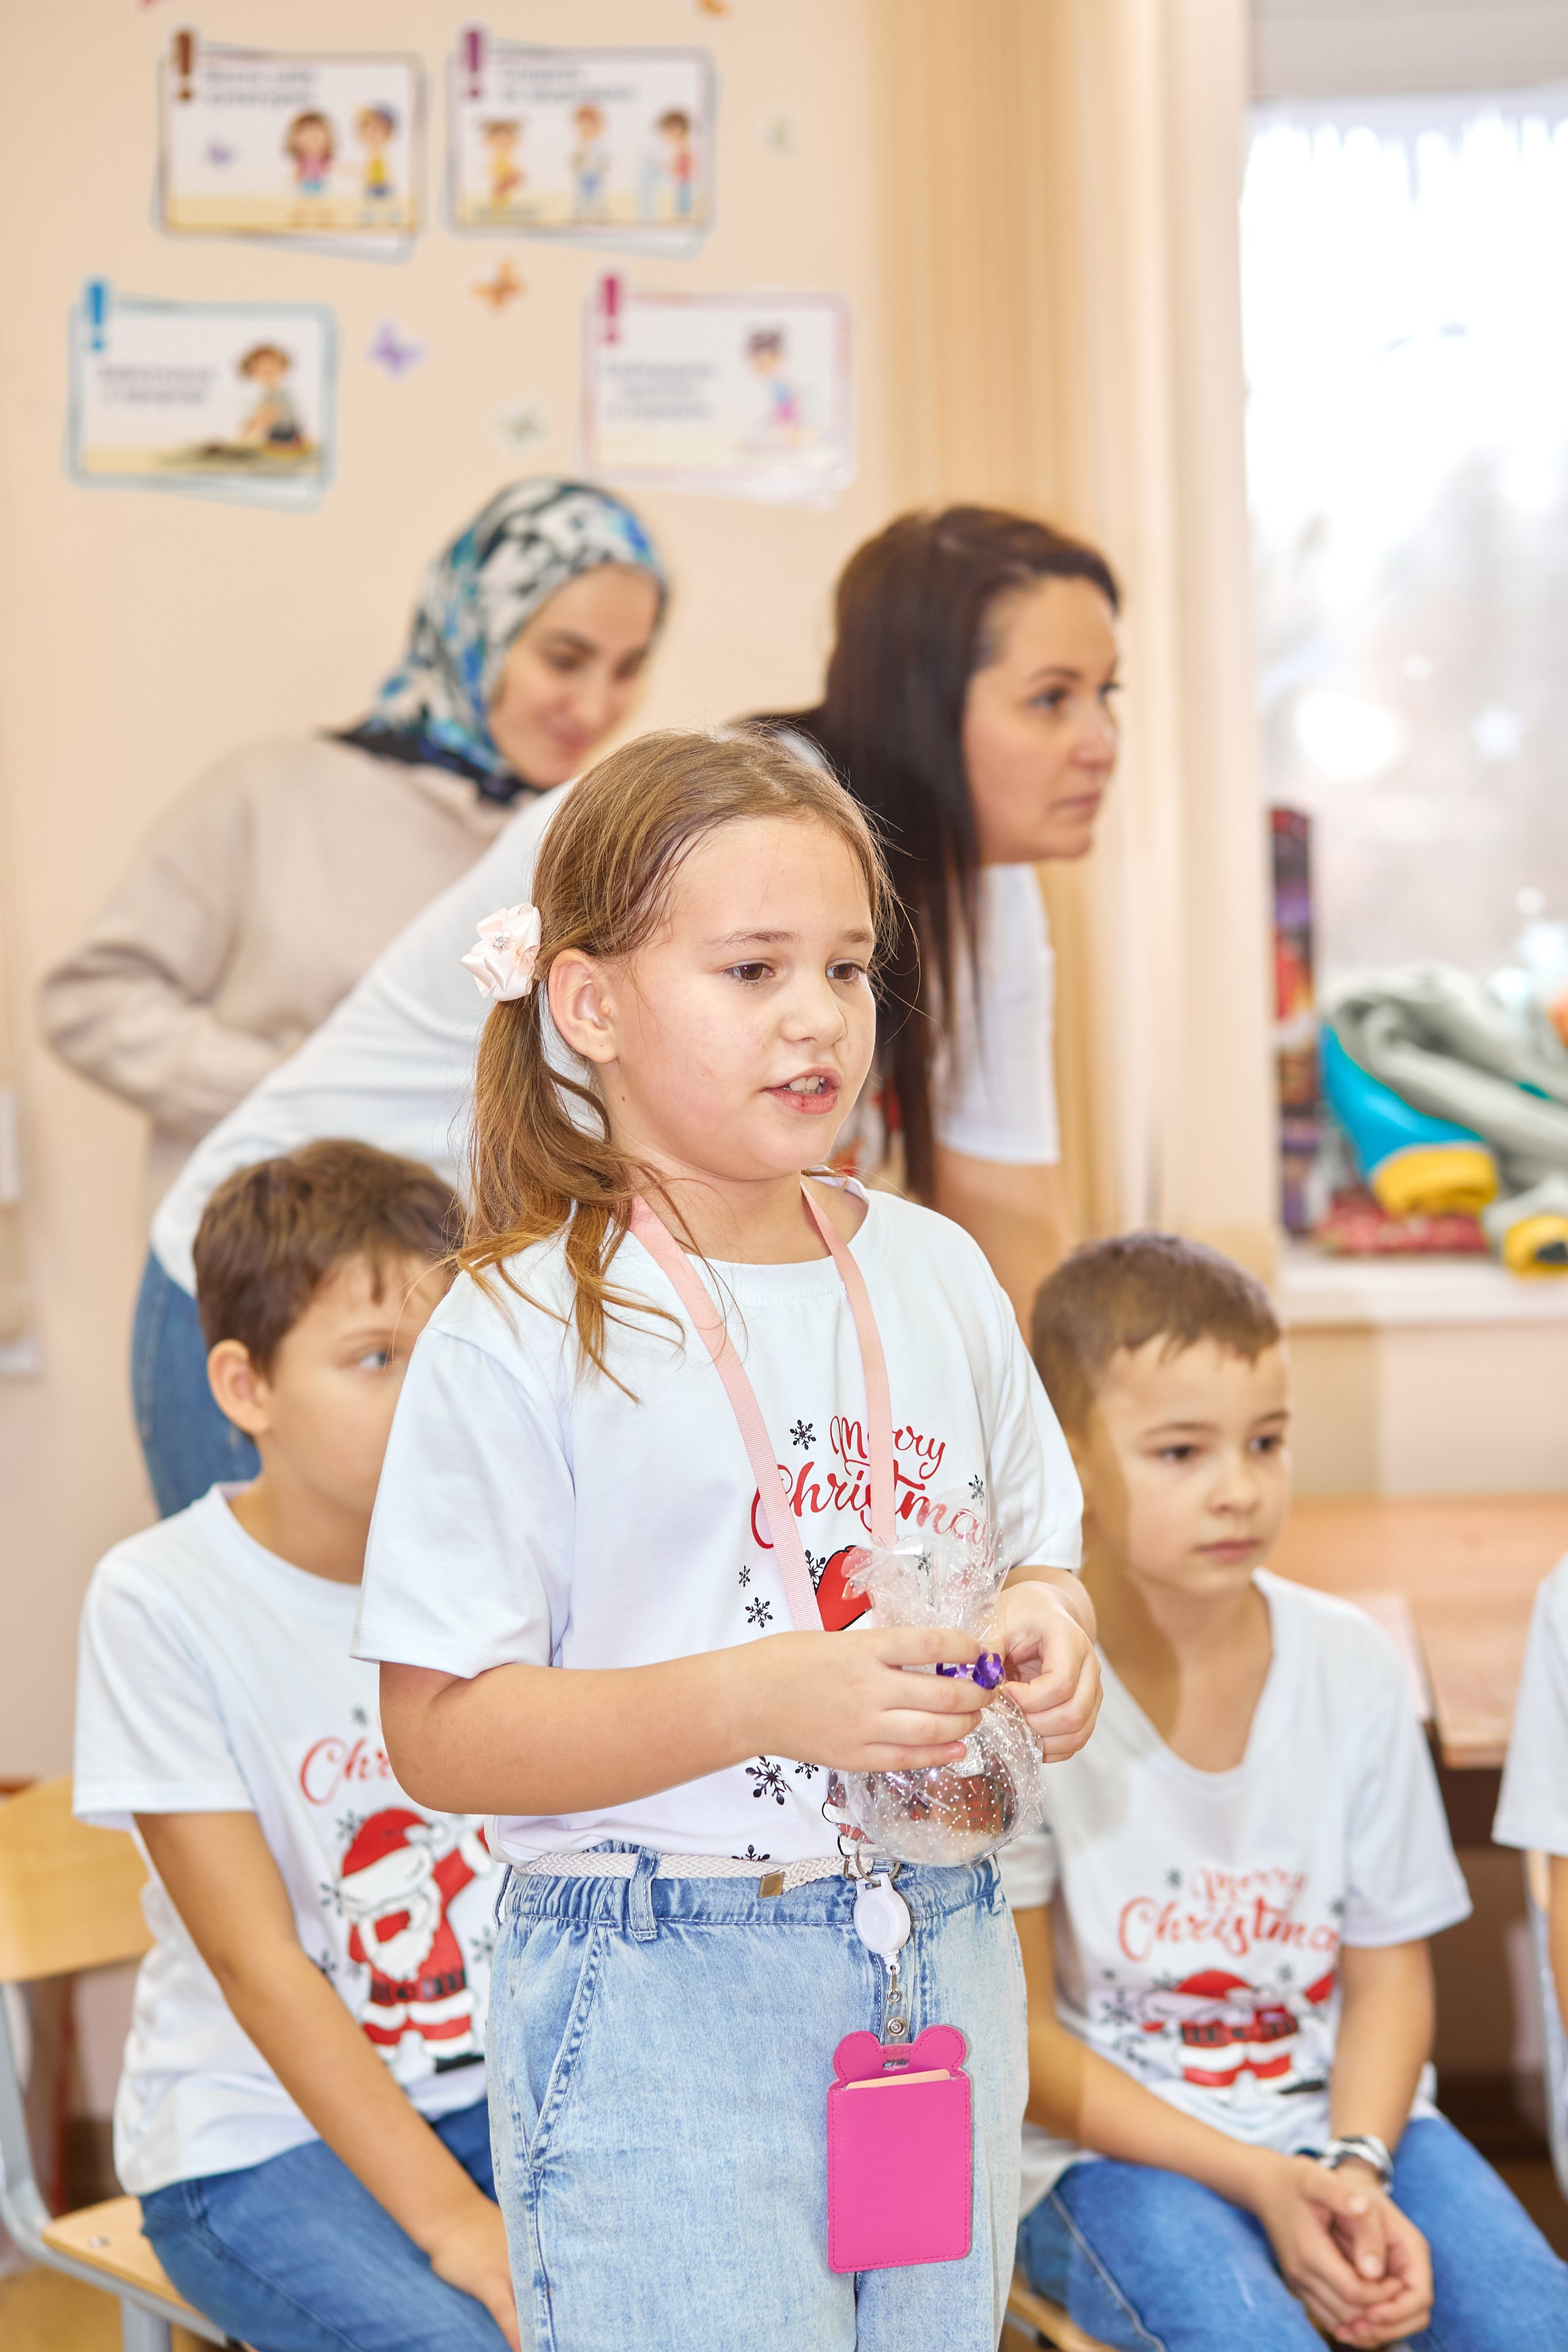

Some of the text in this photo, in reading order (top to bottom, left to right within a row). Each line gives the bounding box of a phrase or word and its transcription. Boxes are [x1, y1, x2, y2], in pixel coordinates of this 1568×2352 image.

[830, 1415, 946, 1480] Mrry
[1189, 1867, 1305, 1912] Merry
[1118, 1896, 1339, 1961] Christma
